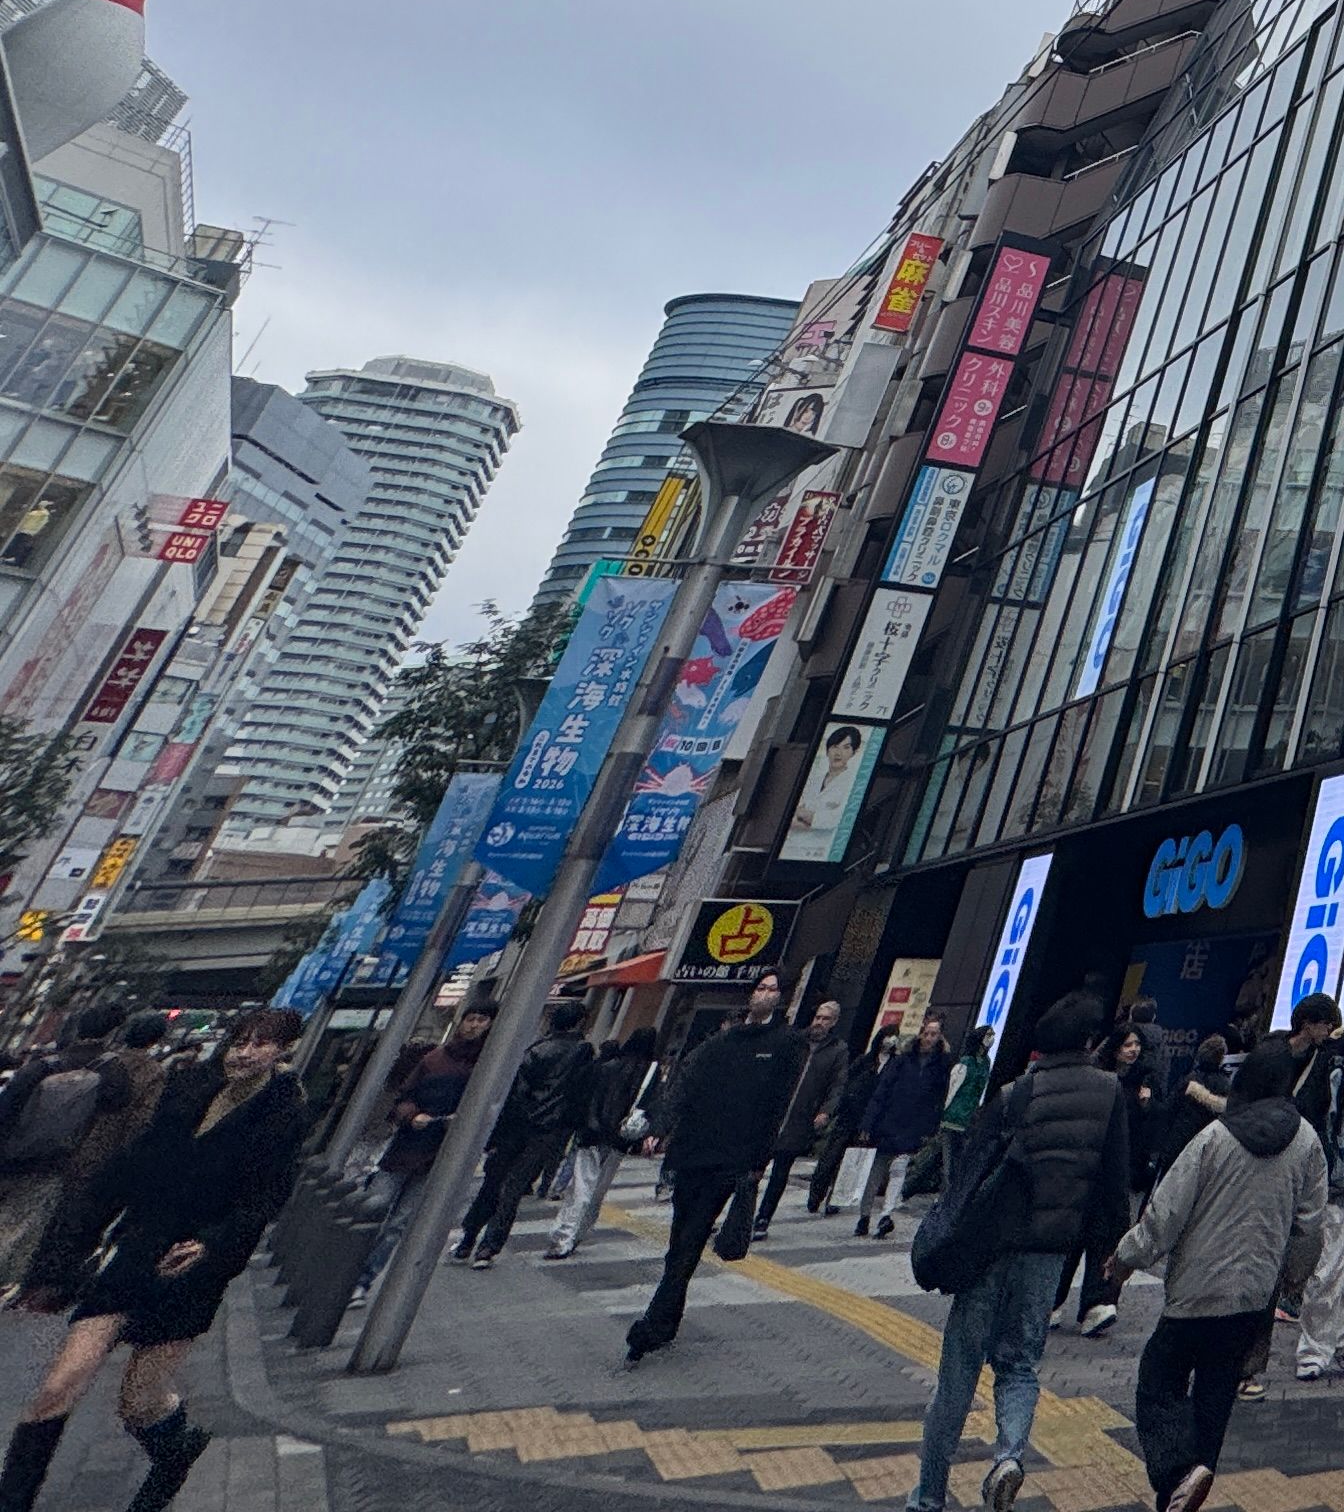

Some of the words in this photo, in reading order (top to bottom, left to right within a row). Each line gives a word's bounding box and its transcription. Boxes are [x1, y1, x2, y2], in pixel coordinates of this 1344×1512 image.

[887, 259, 930, 314] 麻雀
[541, 646, 623, 778] 深海生物
[532, 778, 565, 790] 2026
[1143, 823, 1246, 918] GiGO
[719, 904, 763, 957] 占
